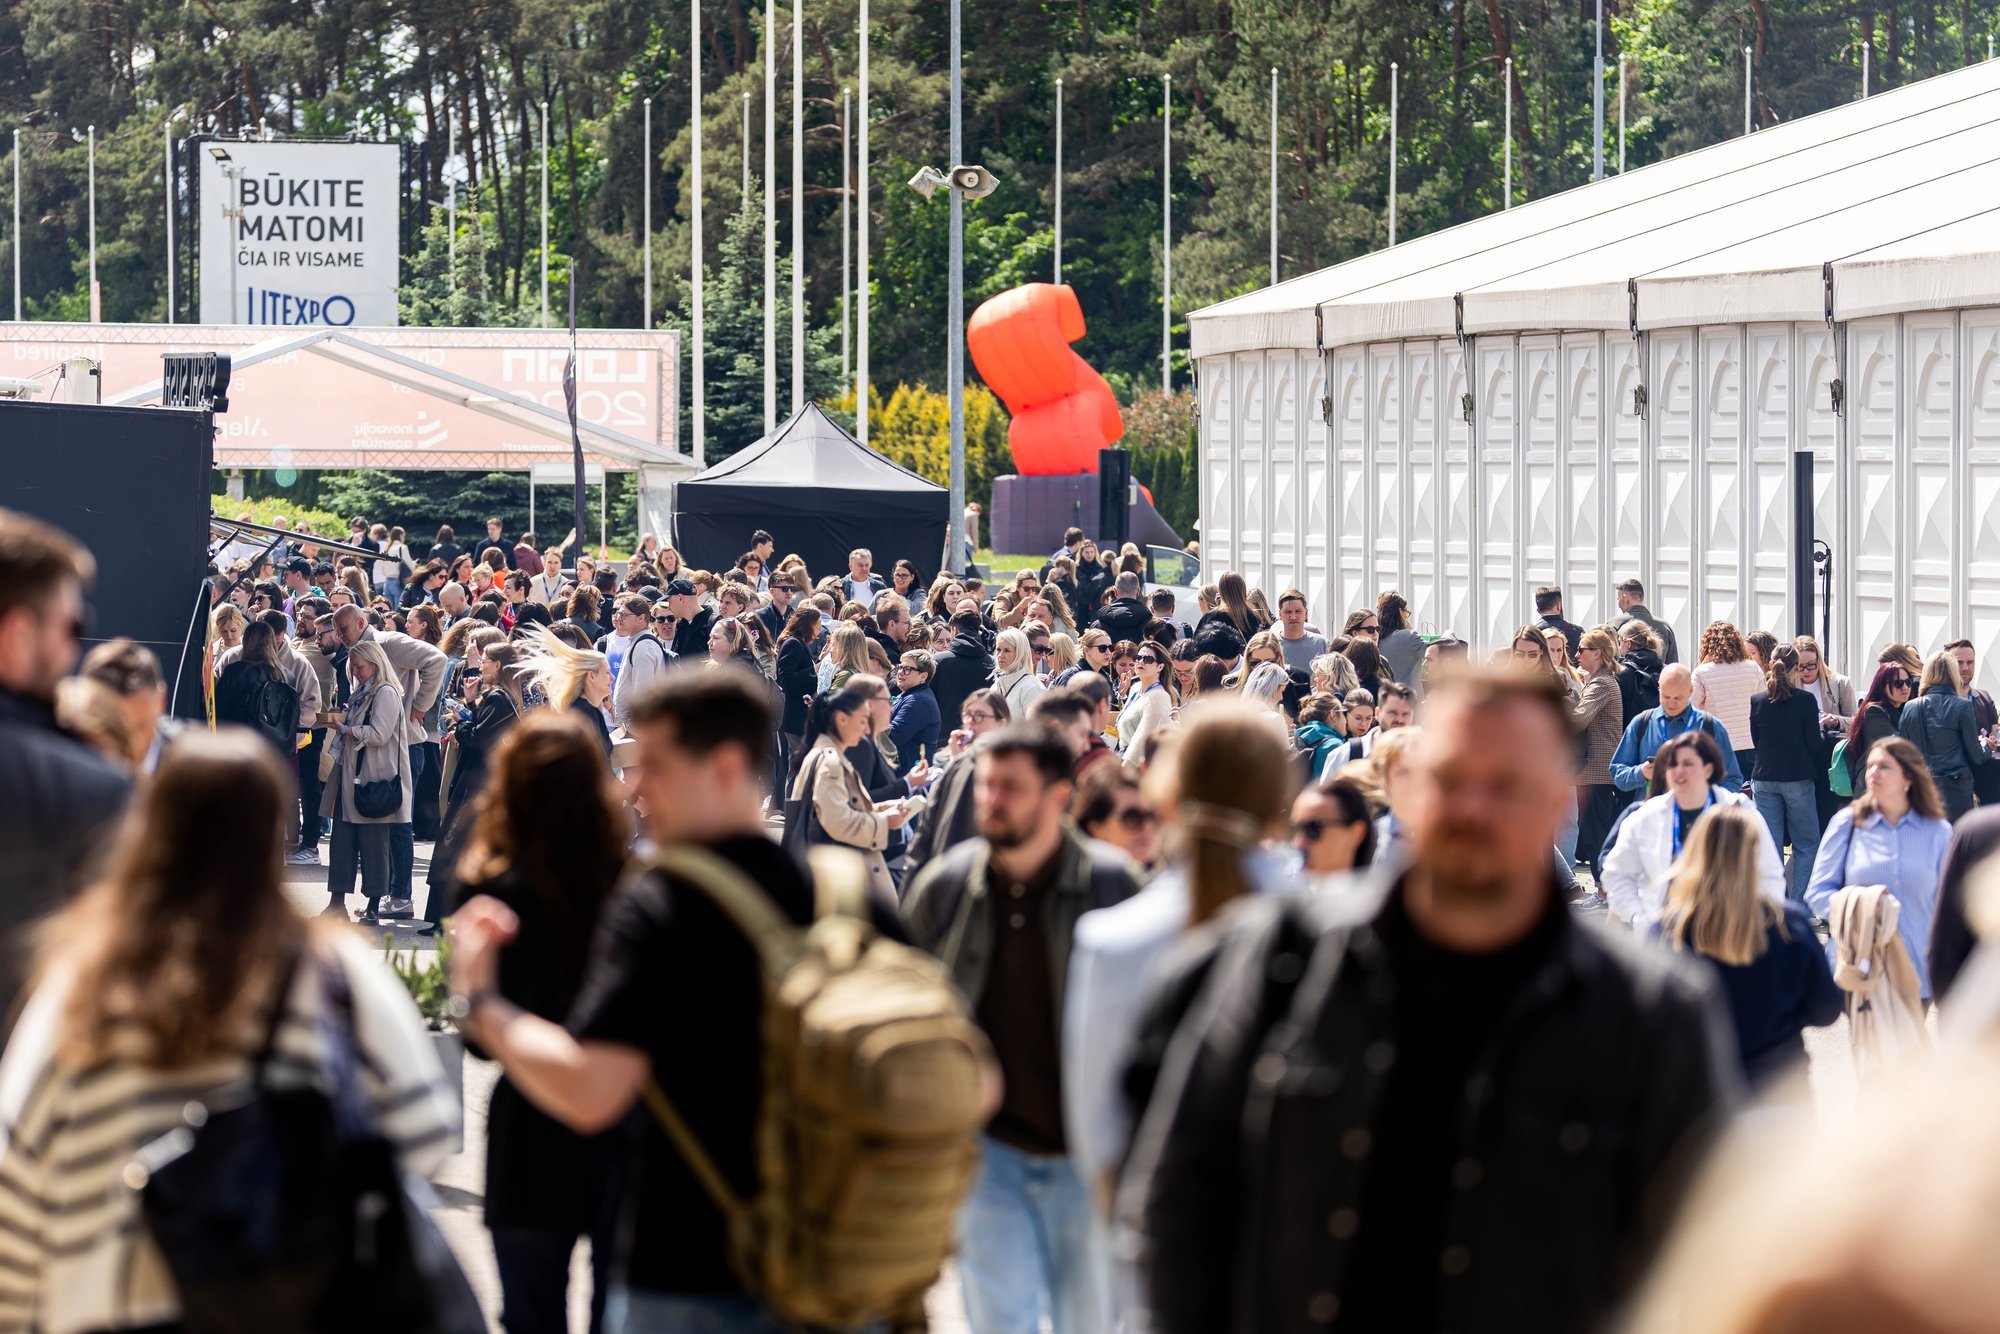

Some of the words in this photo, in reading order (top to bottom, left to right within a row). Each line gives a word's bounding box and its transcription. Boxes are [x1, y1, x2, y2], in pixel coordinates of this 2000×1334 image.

[240, 172, 364, 207] BŪKITE
[239, 215, 363, 242] MATOMI
[238, 245, 267, 266] ČIA
[273, 251, 290, 266] IR
[296, 252, 364, 267] VISAME
